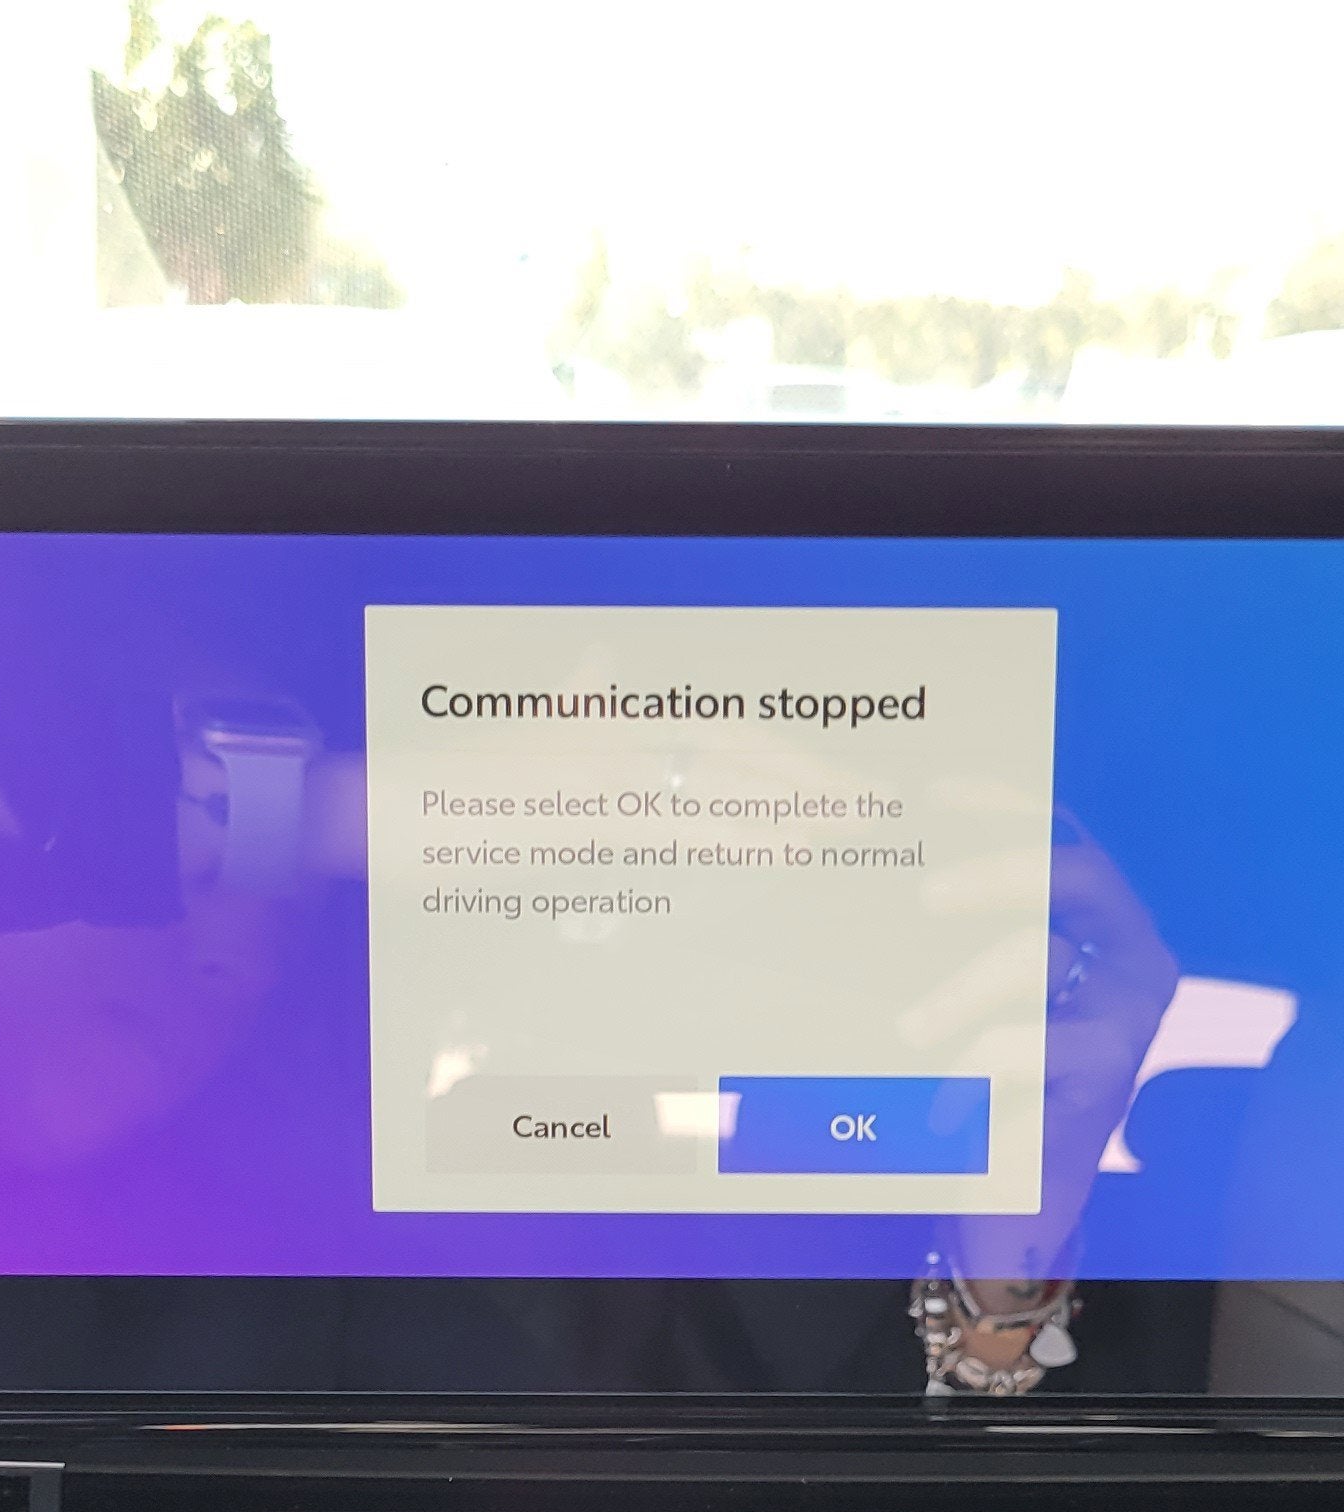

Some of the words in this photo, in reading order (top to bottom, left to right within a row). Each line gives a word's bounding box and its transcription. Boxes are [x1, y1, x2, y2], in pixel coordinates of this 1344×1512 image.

[421, 684, 745, 720] Communication
[758, 684, 927, 728] stopped
[422, 791, 516, 818] Please
[523, 791, 608, 818] select
[616, 793, 663, 818] OK
[671, 795, 700, 818] to
[709, 793, 847, 825] complete
[856, 793, 903, 819] the
[422, 842, 520, 867] service
[530, 841, 614, 867] mode
[622, 842, 677, 867] and
[686, 844, 773, 867] return
[783, 844, 812, 867] to
[821, 842, 926, 868] normal
[422, 889, 522, 920] driving
[531, 889, 671, 920] operation
[512, 1115, 612, 1140] Cancel
[830, 1116, 877, 1142] OK
